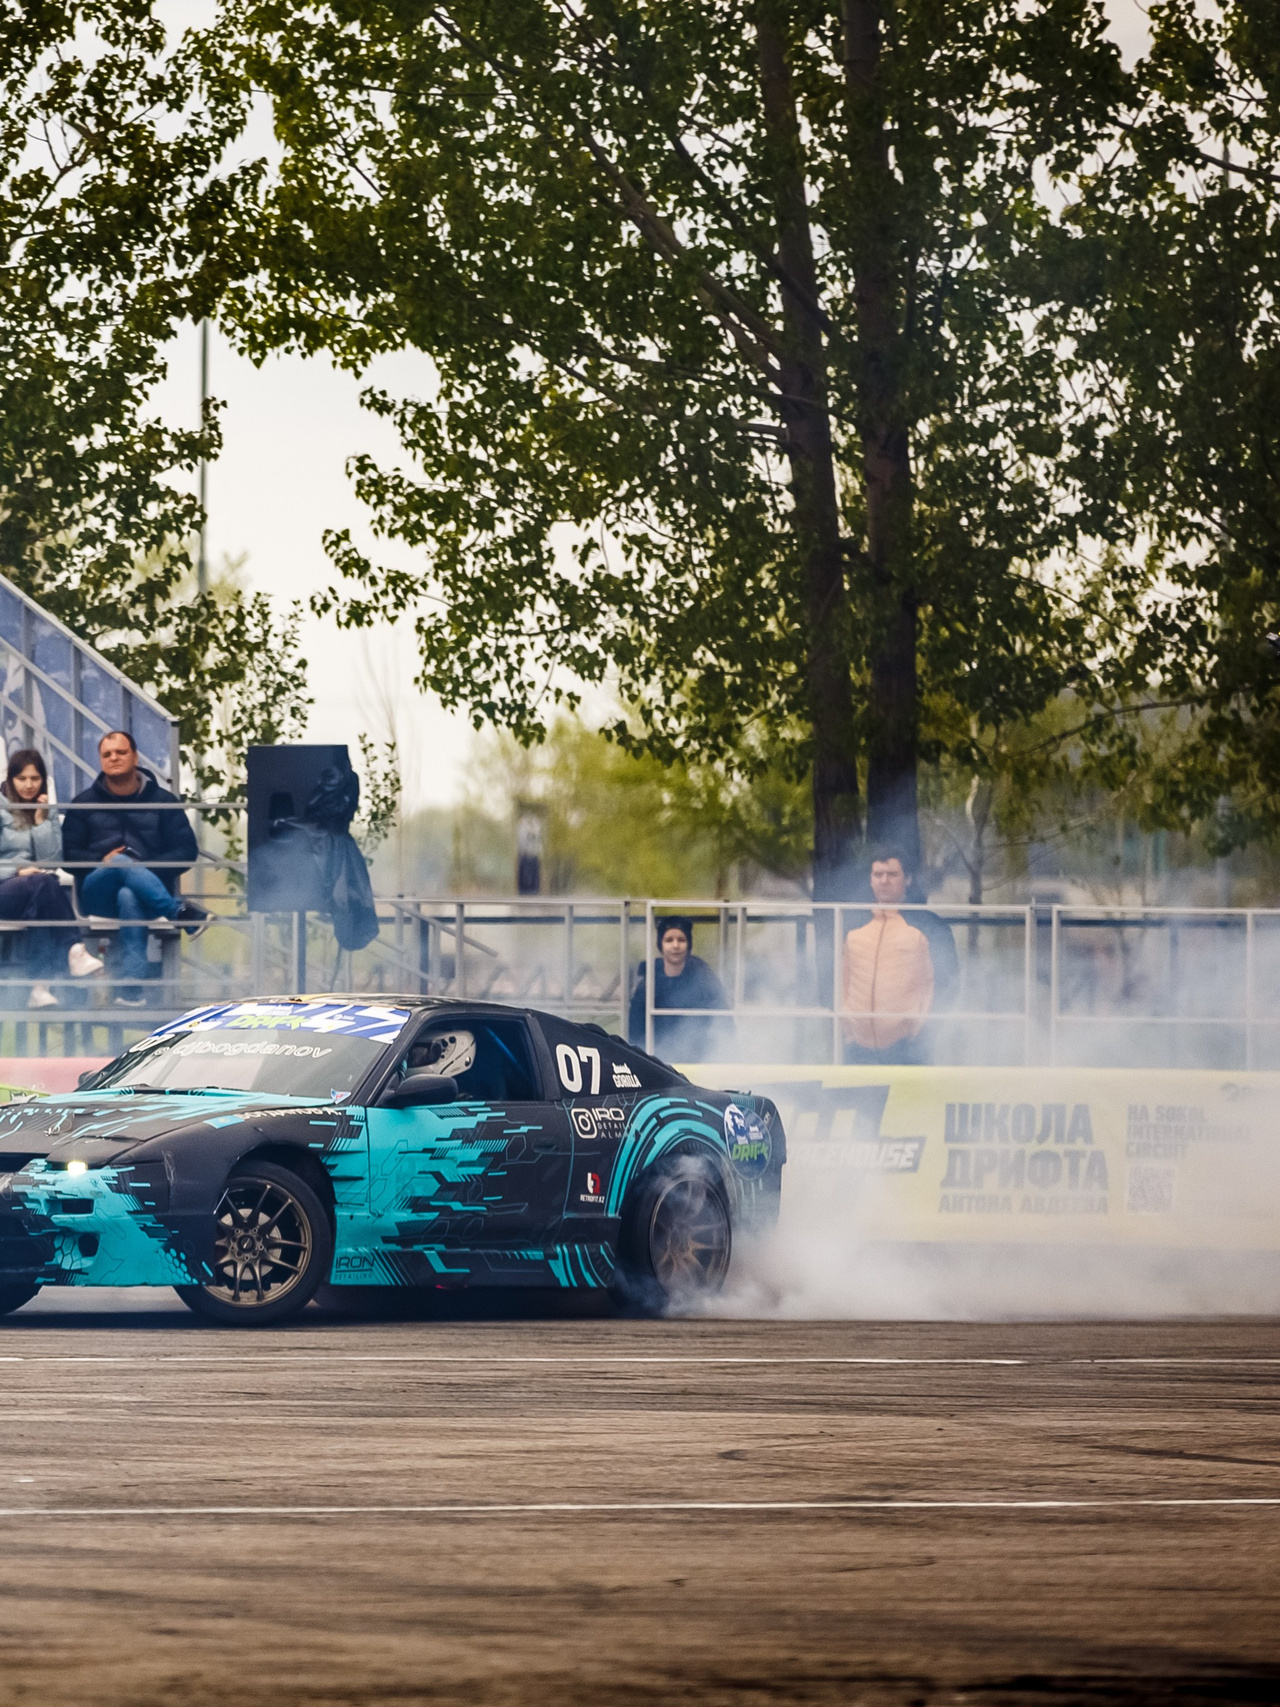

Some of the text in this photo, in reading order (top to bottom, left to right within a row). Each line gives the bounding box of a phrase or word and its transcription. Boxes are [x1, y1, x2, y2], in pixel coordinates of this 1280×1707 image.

[172, 1041, 332, 1059] djbogdanov
[556, 1044, 600, 1094] 07
[612, 1074, 642, 1088] GORILLA
[592, 1108, 625, 1121] IRO
[944, 1103, 1094, 1144] ШКОЛА
[940, 1149, 1109, 1189] ДРИФТА
[938, 1195, 1012, 1214] АНТОНА
[335, 1256, 375, 1269] IRON
